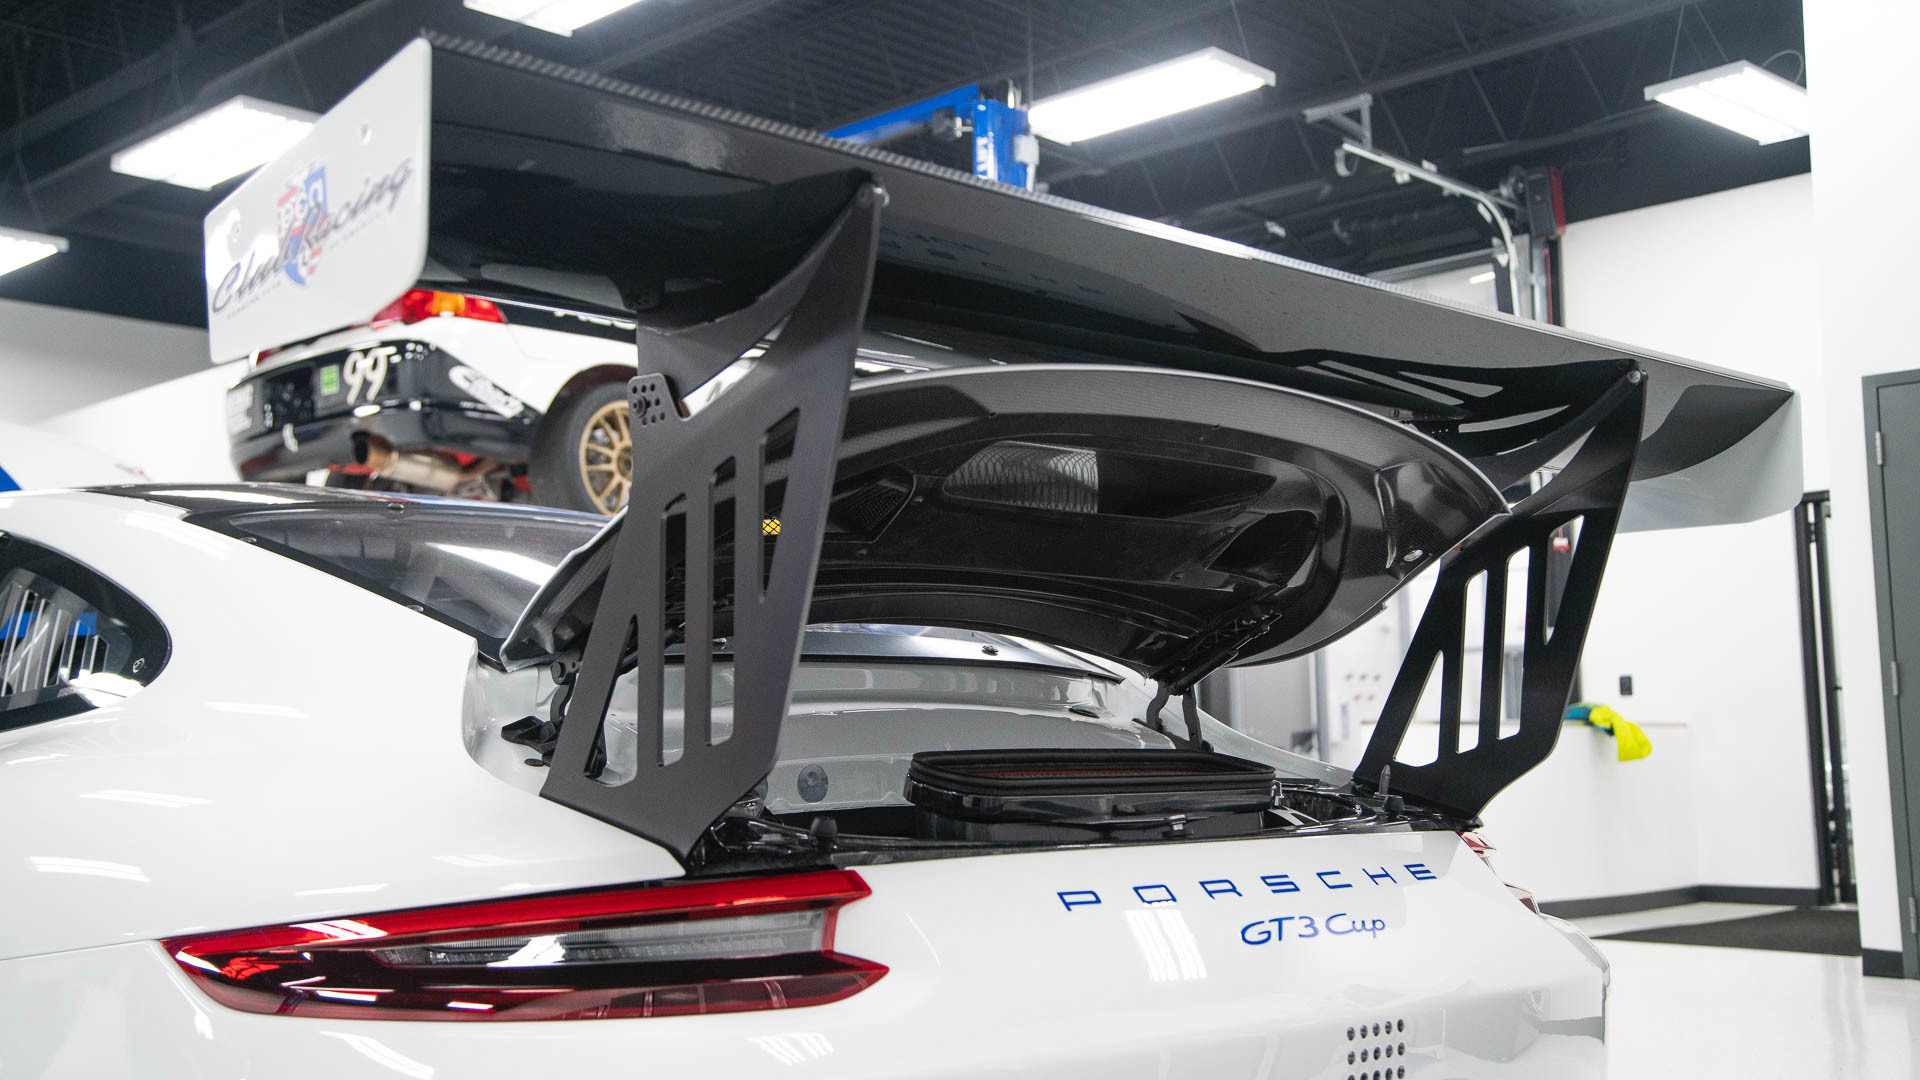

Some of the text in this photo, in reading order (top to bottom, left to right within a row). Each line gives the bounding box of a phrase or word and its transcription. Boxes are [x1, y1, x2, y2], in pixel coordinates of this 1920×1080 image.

[294, 156, 413, 260] Racing
[1057, 863, 1437, 912] PORSCHE
[1240, 912, 1386, 946] GT3 Cup
